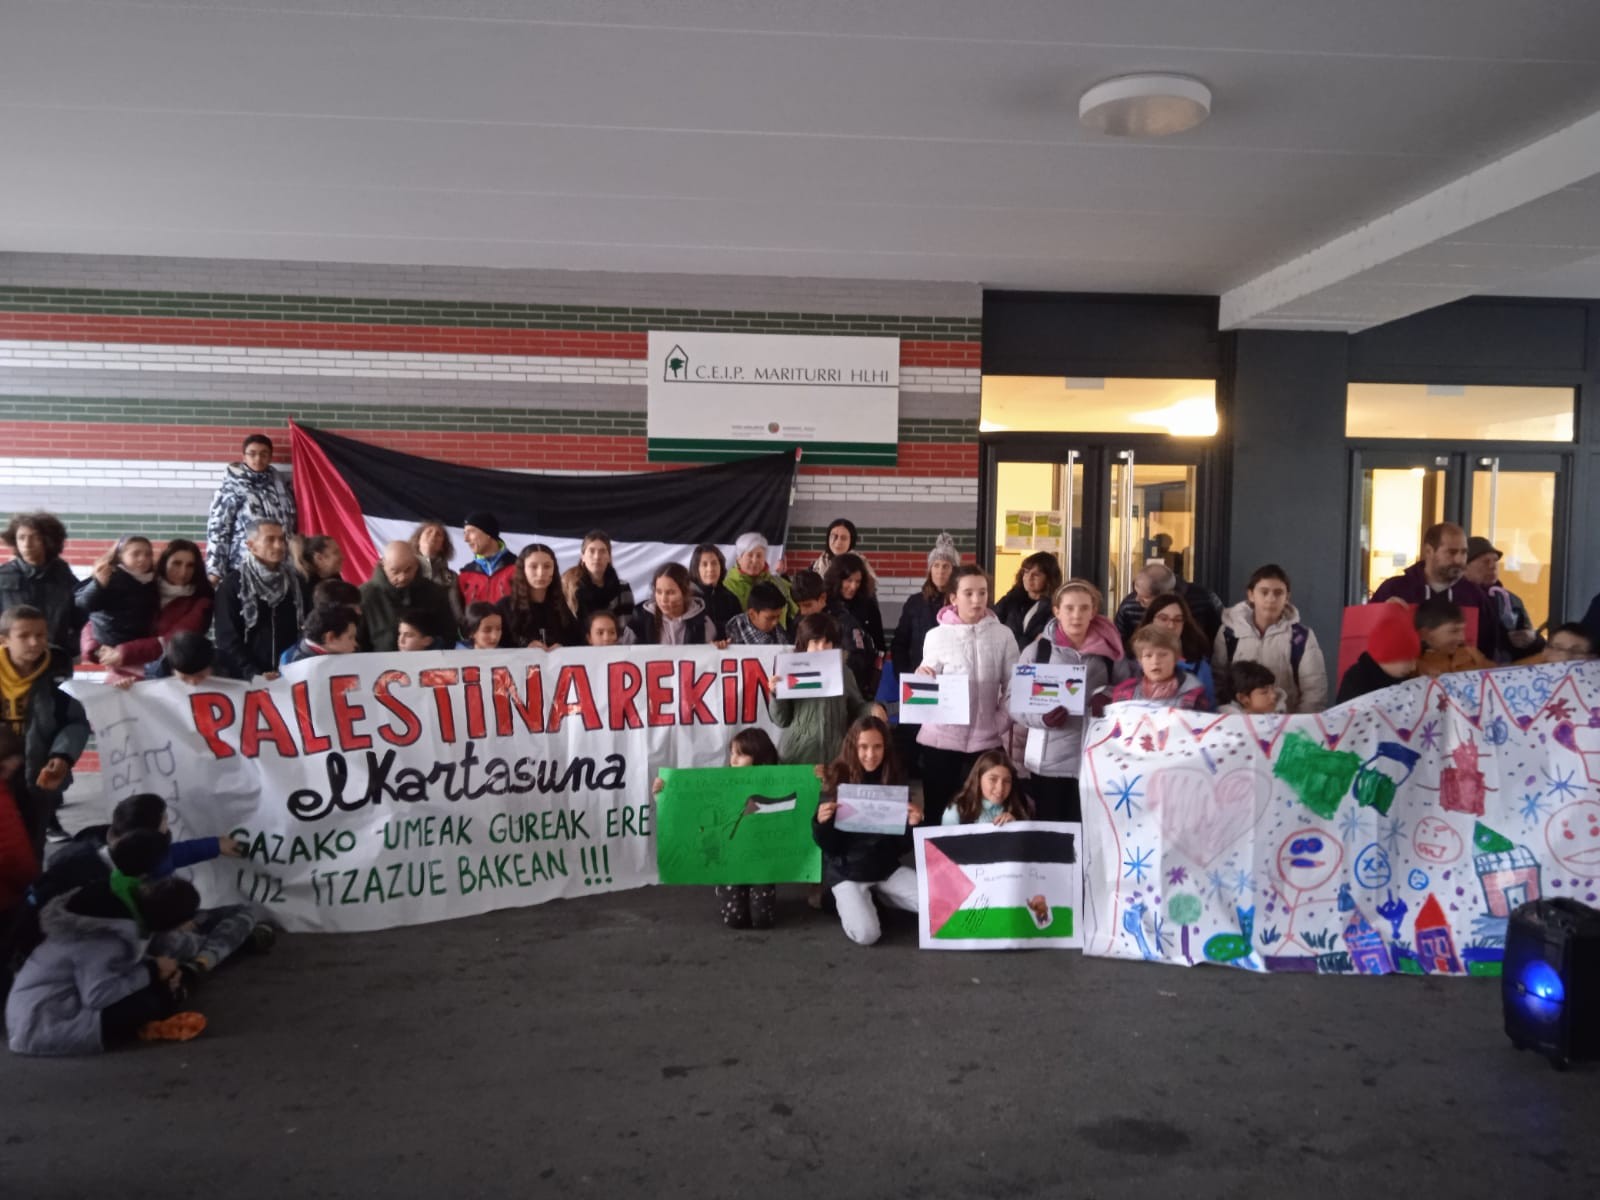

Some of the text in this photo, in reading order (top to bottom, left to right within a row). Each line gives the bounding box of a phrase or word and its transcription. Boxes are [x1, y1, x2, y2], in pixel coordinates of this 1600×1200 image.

[695, 365, 889, 383] C.E.I.P. MARITURRI HLHI
[229, 828, 356, 864] GAZAKO
[489, 809, 590, 843] GUREAK
[606, 805, 652, 838] ERE
[458, 848, 568, 895] BAKEAN
[581, 844, 613, 887] !!!
